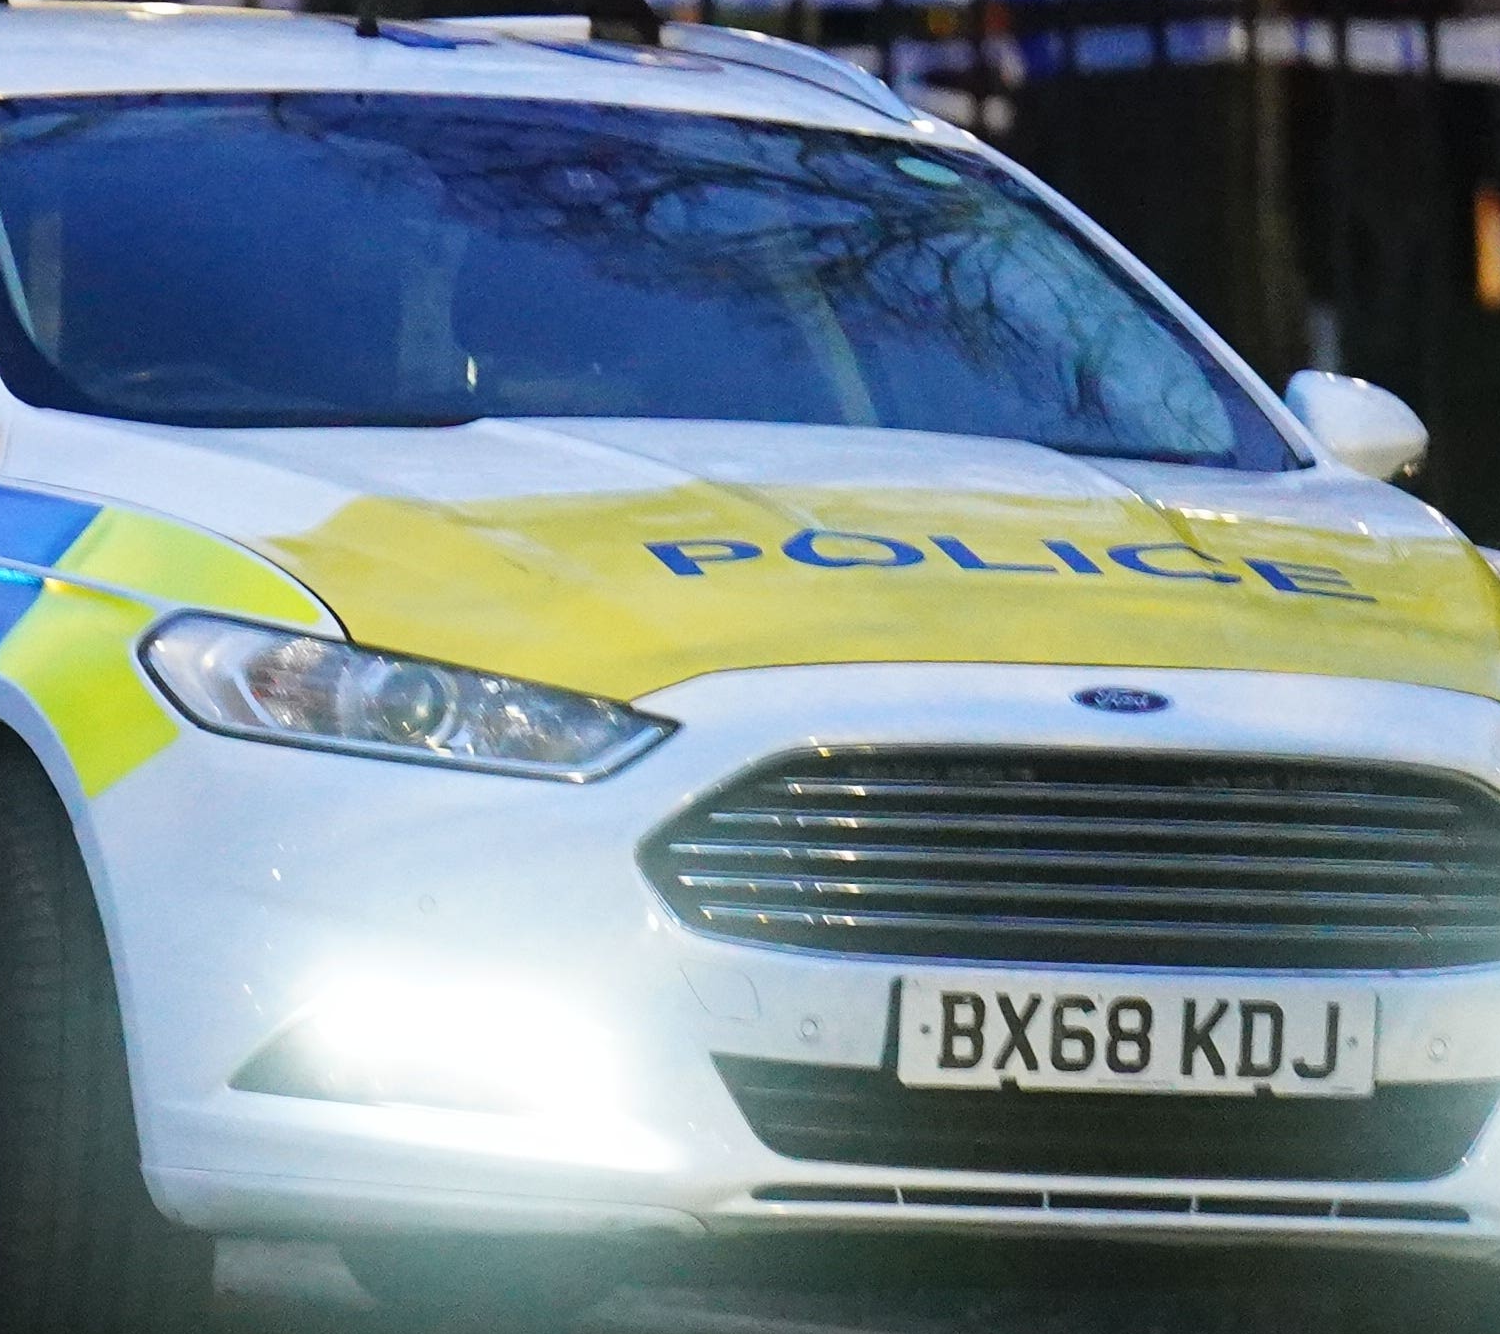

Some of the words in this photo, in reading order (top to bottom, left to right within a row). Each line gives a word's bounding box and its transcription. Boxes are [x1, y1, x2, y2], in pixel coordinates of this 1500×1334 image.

[643, 528, 1378, 603] POLICE
[938, 990, 1153, 1074] BX68
[1180, 997, 1341, 1079] KDJ
